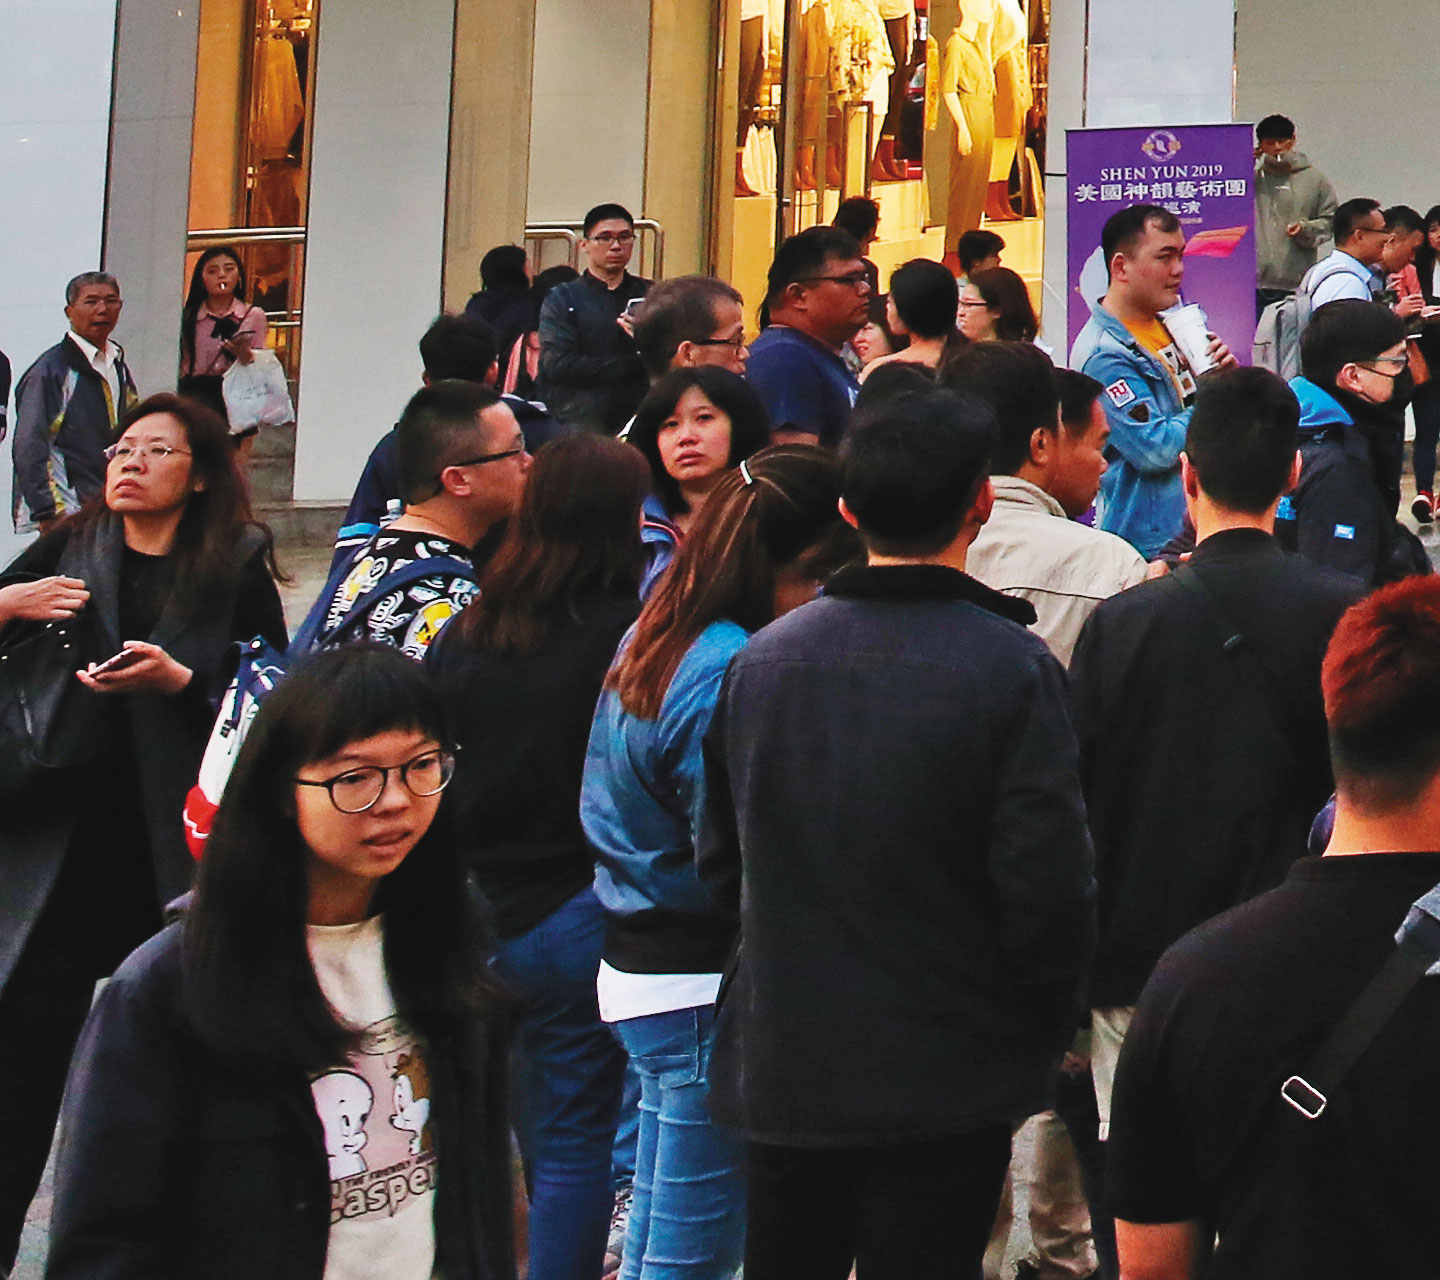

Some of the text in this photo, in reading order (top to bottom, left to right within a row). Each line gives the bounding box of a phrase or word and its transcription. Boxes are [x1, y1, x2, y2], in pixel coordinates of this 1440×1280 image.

[1100, 165, 1223, 181] SHEN YUN 2019
[1074, 179, 1246, 203] 美國神韻藝術團
